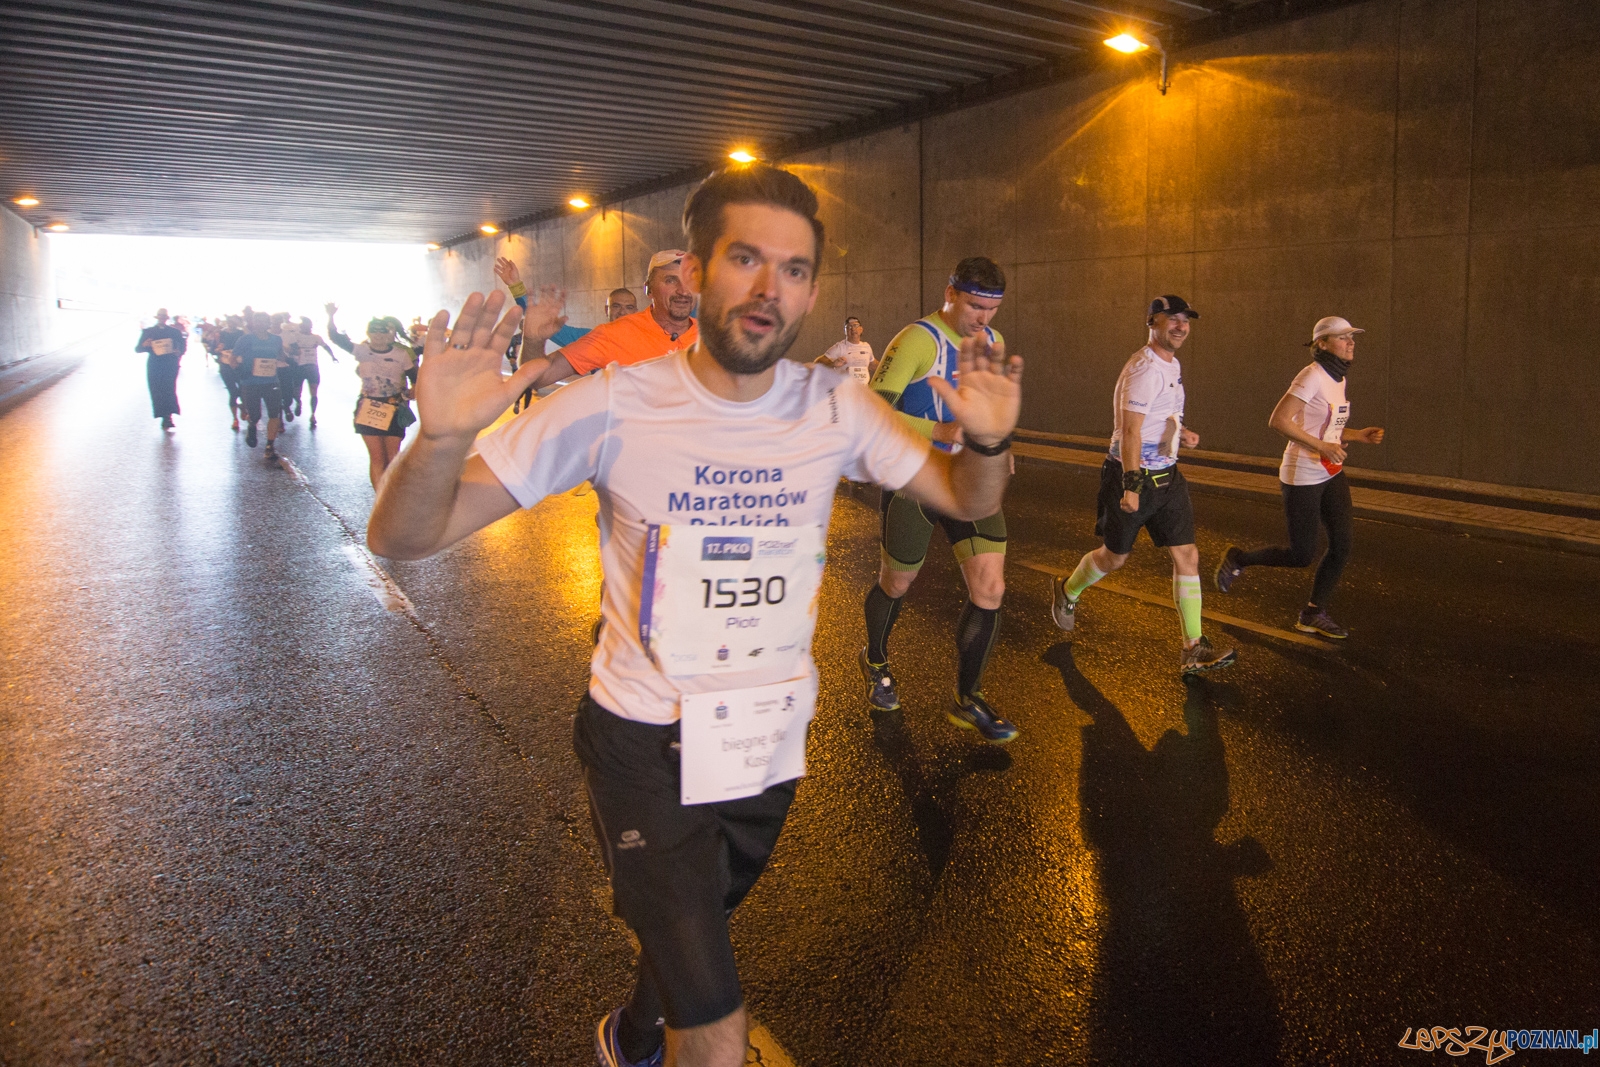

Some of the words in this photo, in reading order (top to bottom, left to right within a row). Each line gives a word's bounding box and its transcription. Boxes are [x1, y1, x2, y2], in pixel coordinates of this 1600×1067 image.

[367, 408, 387, 419] 2709
[695, 465, 783, 485] Korona
[668, 487, 808, 512] Maratonów
[722, 543, 749, 554] PKO
[701, 575, 786, 609] 1530
[725, 616, 761, 629] Piotr
